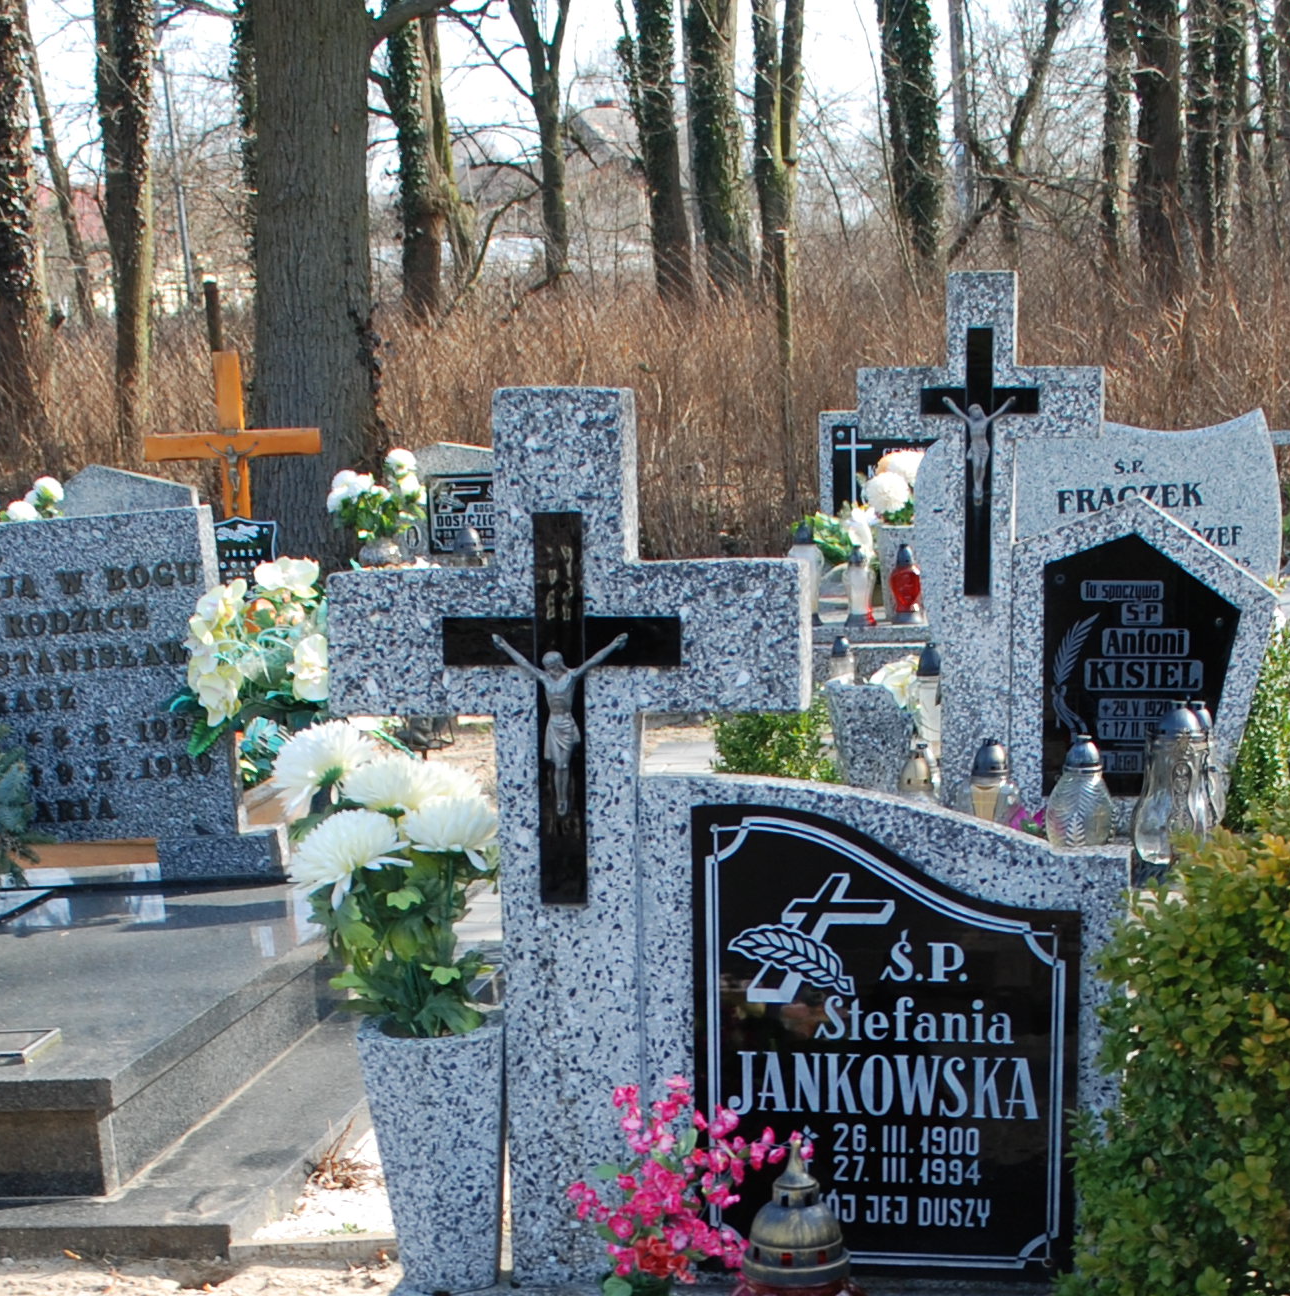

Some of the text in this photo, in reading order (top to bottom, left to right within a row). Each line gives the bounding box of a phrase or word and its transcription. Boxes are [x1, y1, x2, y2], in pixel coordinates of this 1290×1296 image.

[1114, 458, 1145, 475] Ś.P.
[55, 568, 84, 596] W
[1101, 583, 1160, 602] spoczywa
[3, 603, 148, 639] RODZICE
[1105, 628, 1186, 656] Antoni
[1088, 660, 1200, 690] KISIEL
[880, 928, 968, 983] Ś.P.
[814, 993, 1015, 1045] Stefania
[728, 1051, 1040, 1120] JANKOWSKA
[866, 1195, 909, 1225] JEJ
[917, 1197, 991, 1228] DUSZY
